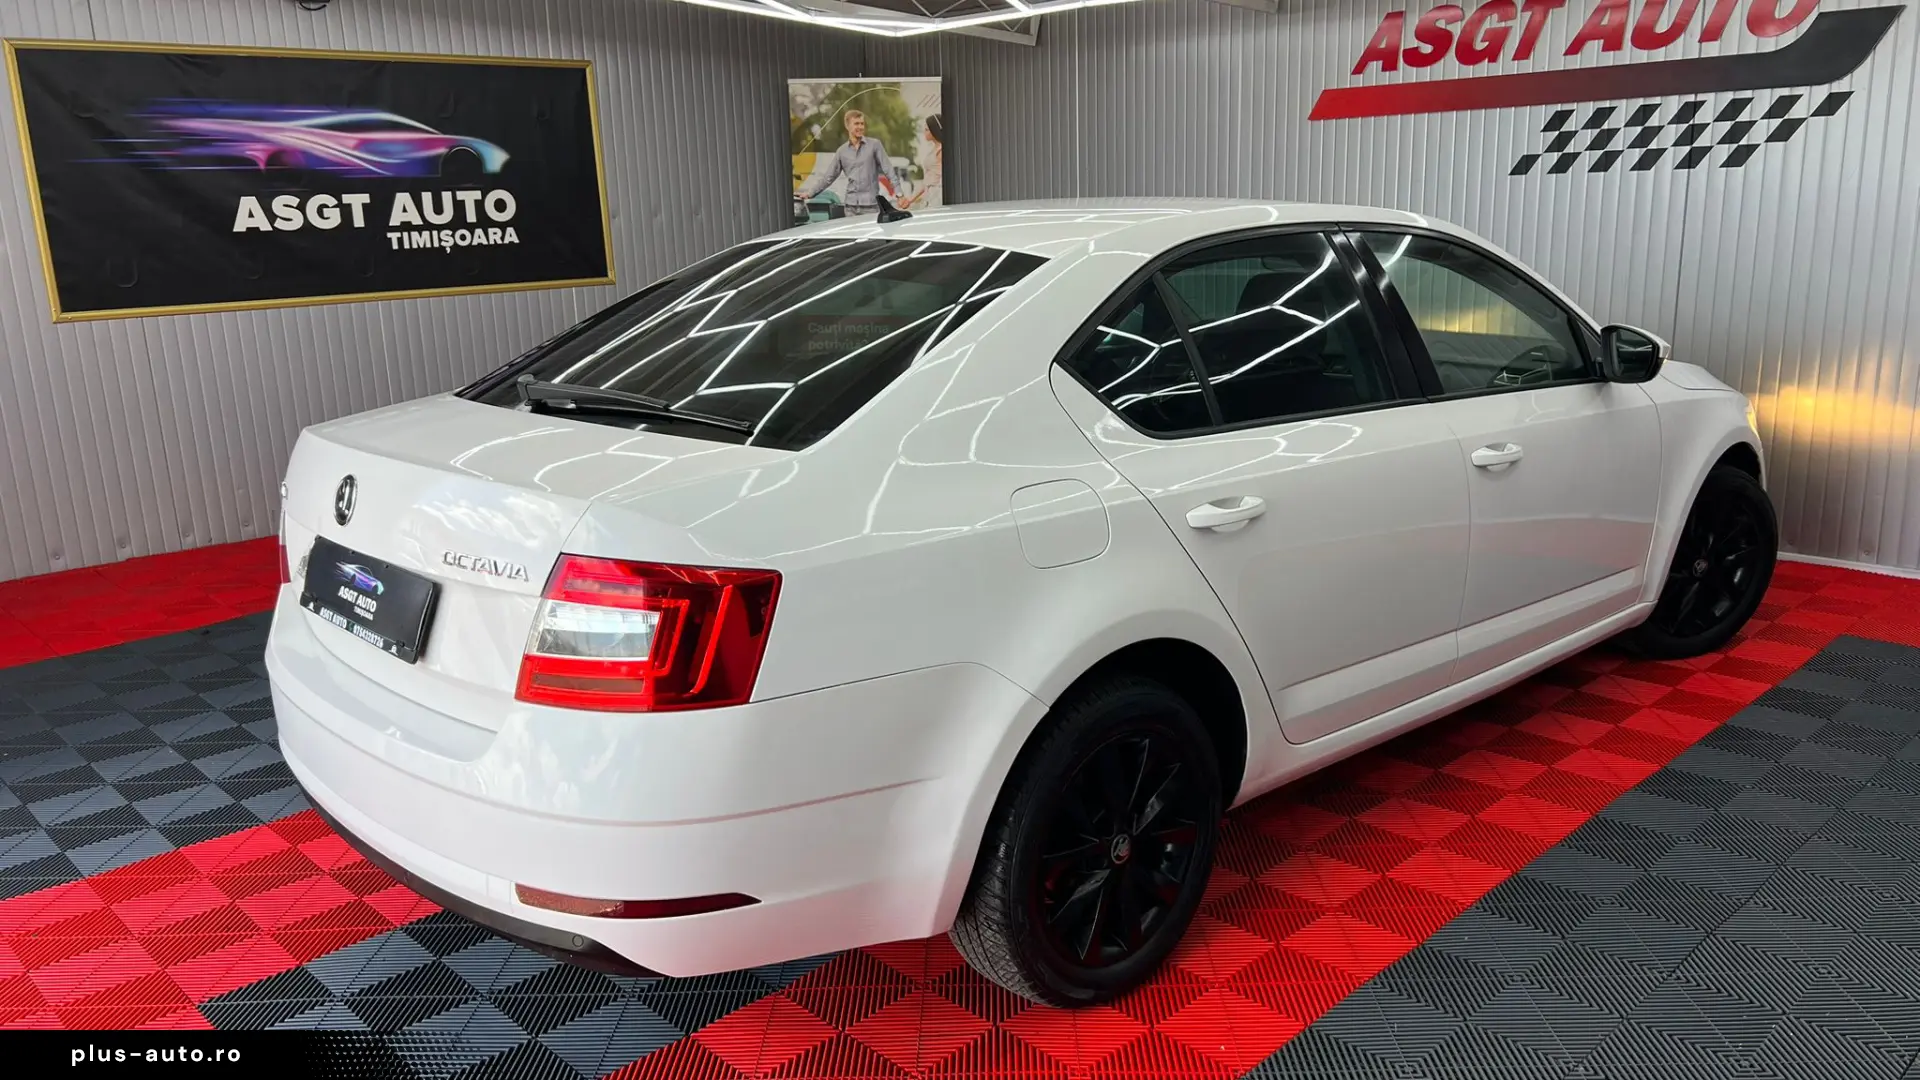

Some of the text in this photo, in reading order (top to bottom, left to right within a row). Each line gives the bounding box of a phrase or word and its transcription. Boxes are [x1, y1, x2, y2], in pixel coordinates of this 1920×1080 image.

[1351, 0, 1567, 75] ASGT
[232, 189, 517, 232] ASGT AUTO
[386, 227, 520, 254] TIMIȘOARA
[441, 550, 530, 582] OCTAVIA
[338, 585, 377, 612] ASGT AUTO
[319, 606, 334, 622] ASGT
[333, 613, 348, 629] AUTO
